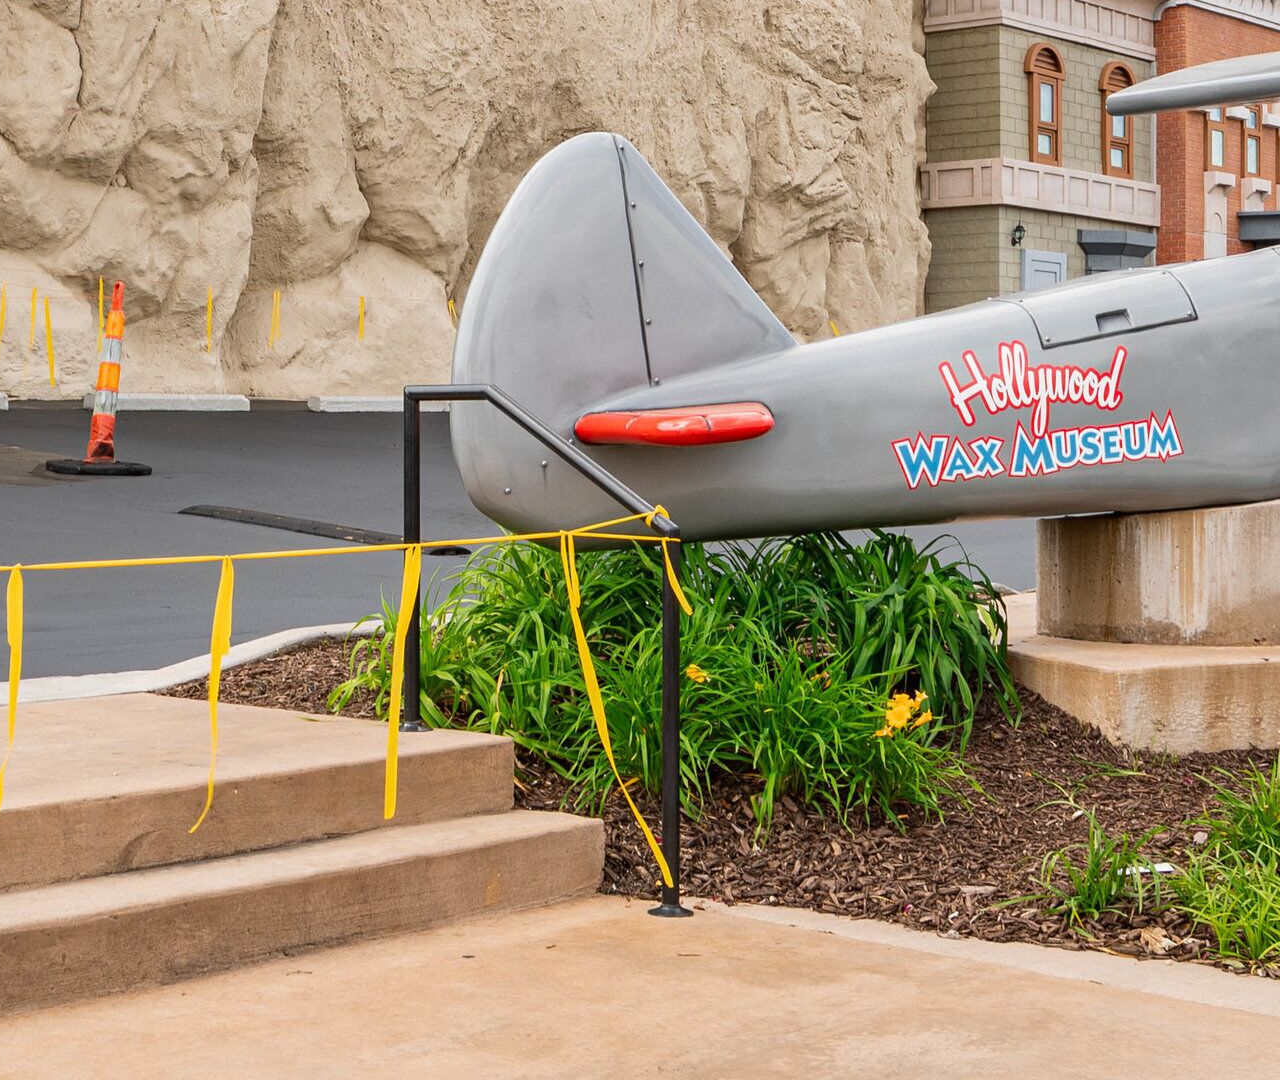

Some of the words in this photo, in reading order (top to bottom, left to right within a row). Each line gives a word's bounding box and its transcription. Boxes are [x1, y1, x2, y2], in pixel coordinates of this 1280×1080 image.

[938, 340, 1128, 438] Hollywood
[890, 431, 1005, 490] WAX
[1008, 408, 1184, 479] MUSEUM
